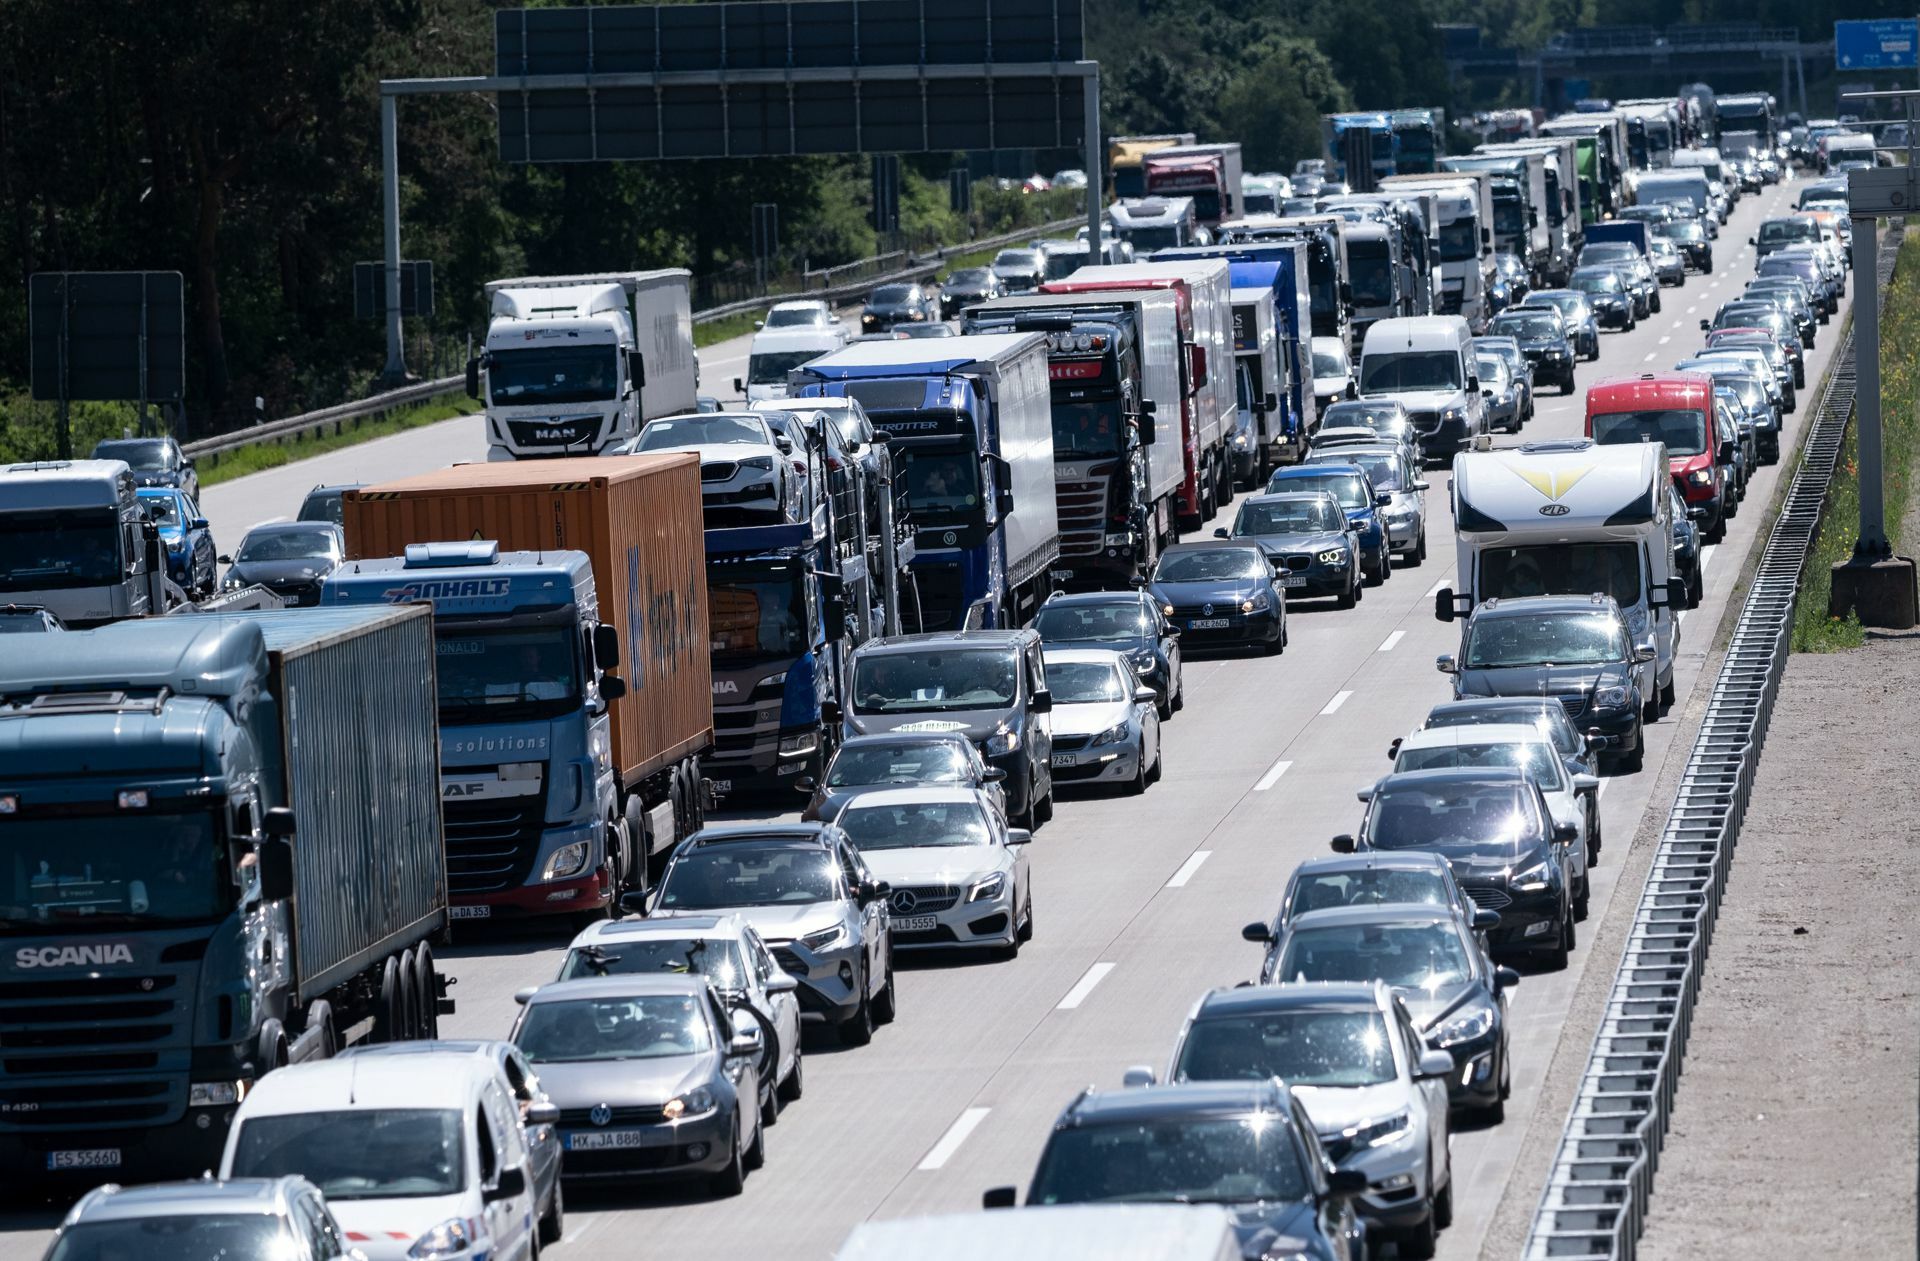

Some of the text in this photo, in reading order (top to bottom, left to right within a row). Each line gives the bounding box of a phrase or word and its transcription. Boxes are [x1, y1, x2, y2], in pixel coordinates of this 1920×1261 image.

[536, 428, 576, 439] MAN
[389, 578, 512, 605] ANHALT
[712, 680, 739, 693] NIA
[456, 736, 546, 753] solutions
[1053, 755, 1074, 765] 7347
[442, 783, 484, 796] AF
[460, 907, 471, 917] DA
[473, 906, 489, 916] 353
[899, 917, 935, 930] LD 5555
[15, 944, 134, 968] SCANIA
[12, 1102, 39, 1111] 420
[572, 1131, 639, 1148] HX JA 888
[55, 1150, 119, 1168] ES 55660
